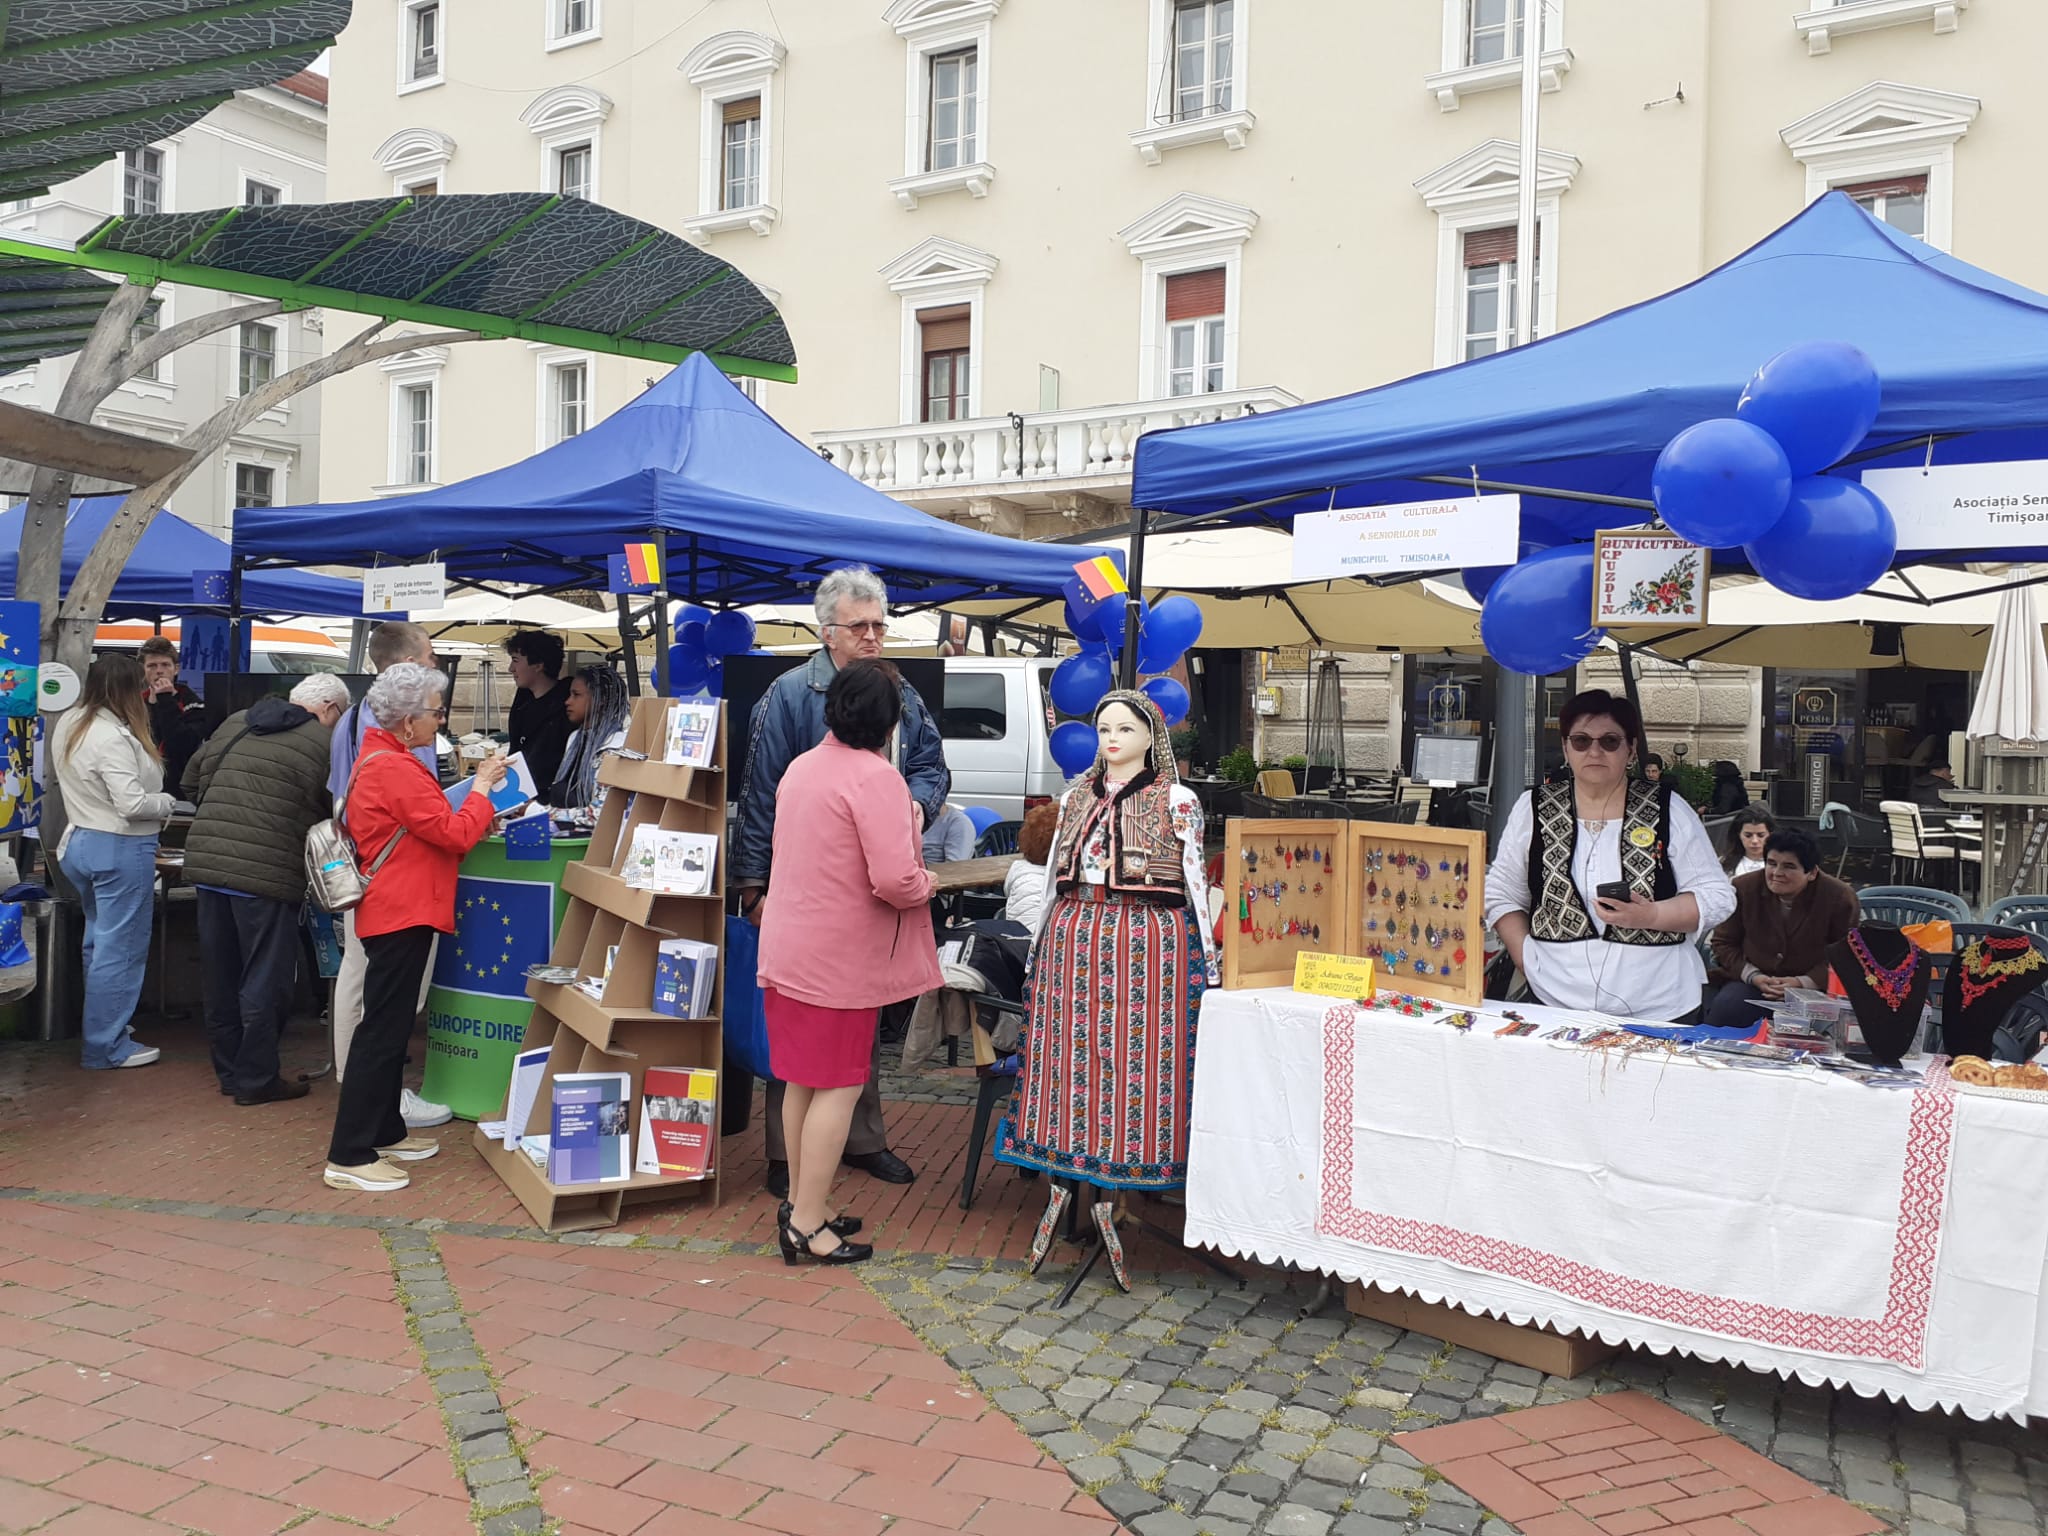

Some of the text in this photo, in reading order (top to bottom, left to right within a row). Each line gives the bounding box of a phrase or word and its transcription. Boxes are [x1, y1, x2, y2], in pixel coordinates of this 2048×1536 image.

[1339, 505, 1458, 522] ASOCIATIA CULTURALA
[1359, 528, 1437, 541] A SENIORILOR DIN
[1341, 553, 1450, 565] MUNICIPIUL TIMISOARA
[1812, 761, 1821, 809] DUNHILL
[663, 991, 676, 1003] EU
[429, 1010, 528, 1043] EUROPE DIRE
